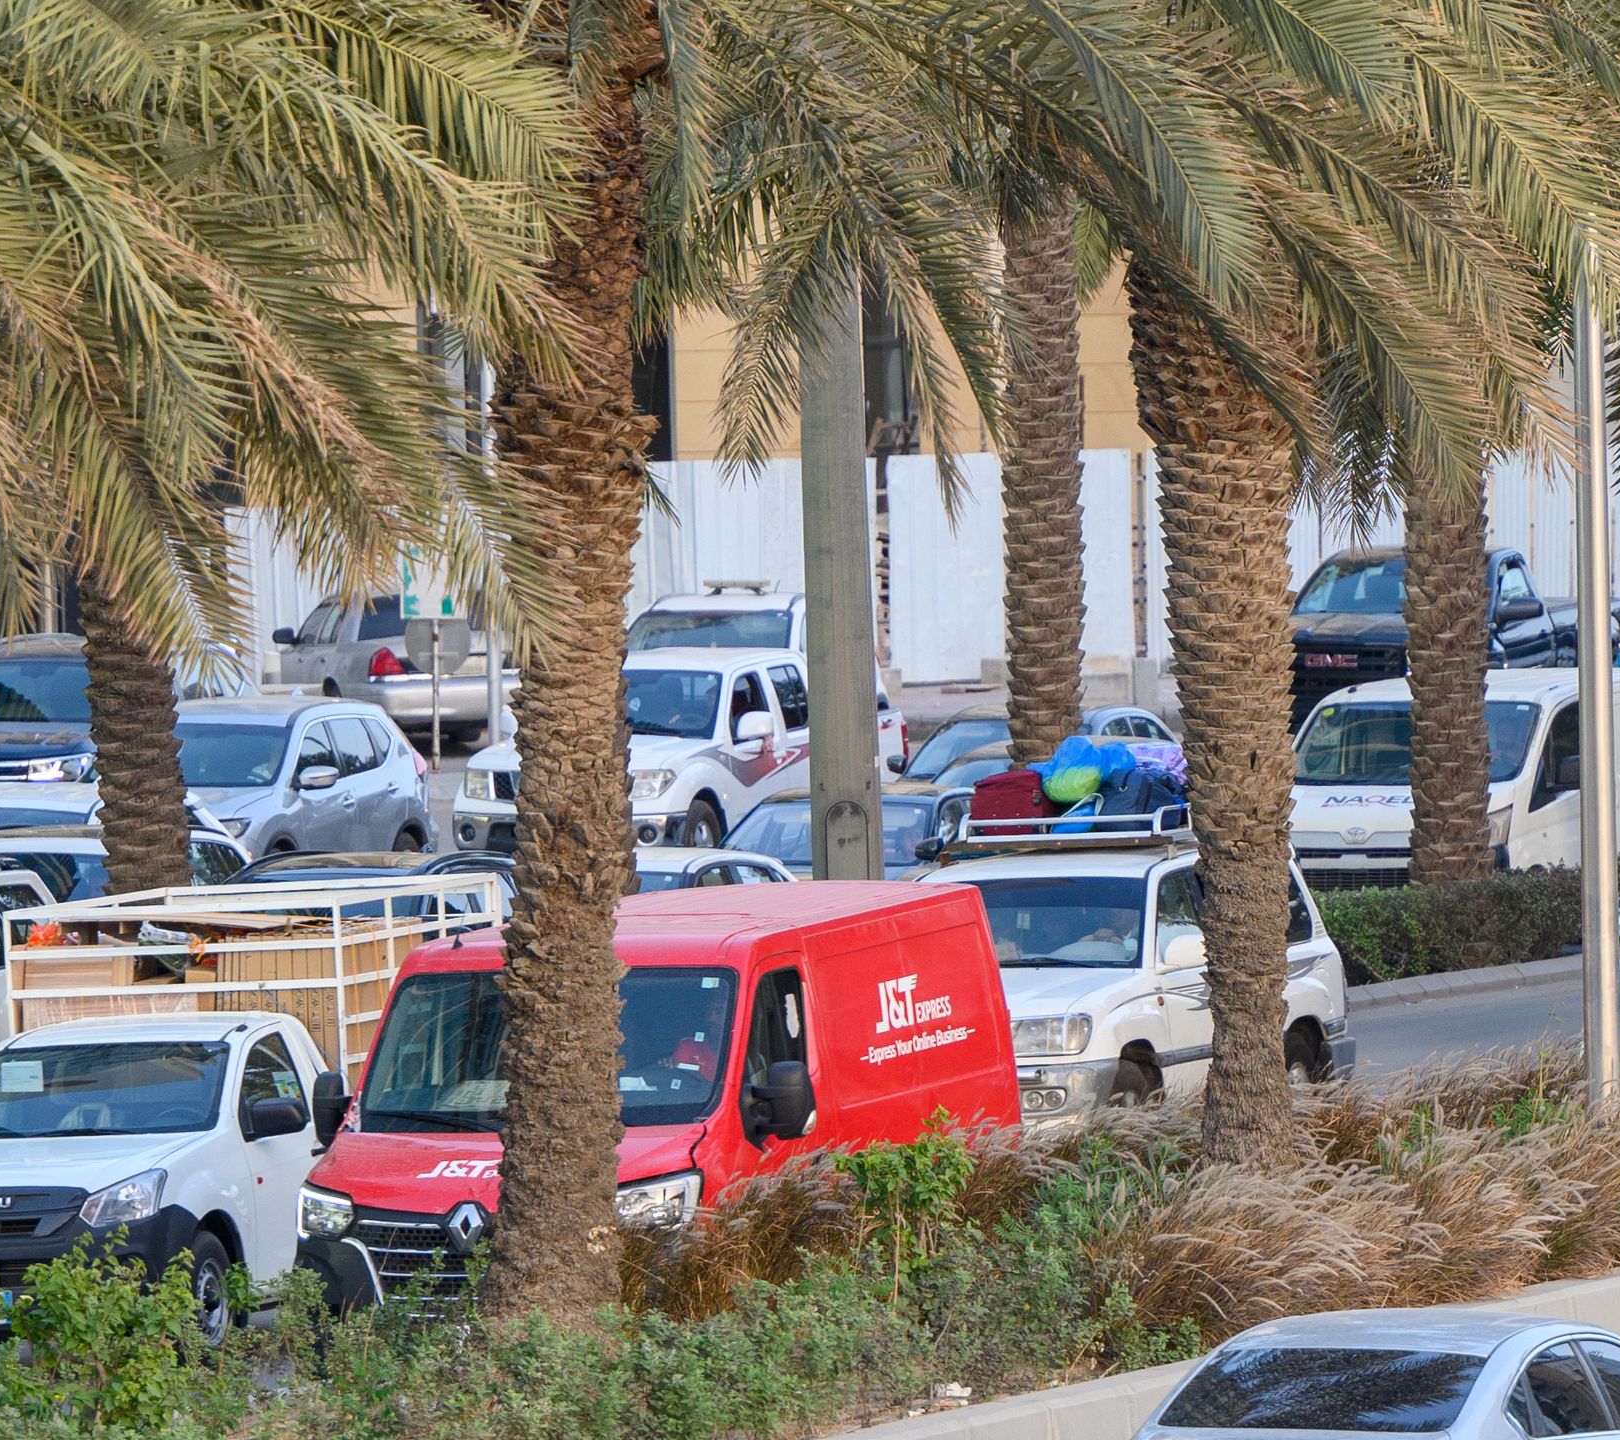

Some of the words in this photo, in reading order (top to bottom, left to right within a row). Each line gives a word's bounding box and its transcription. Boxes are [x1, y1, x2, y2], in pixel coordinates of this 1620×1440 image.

[1305, 654, 1358, 666] GMC
[876, 974, 918, 1034] J&T
[915, 995, 952, 1024] EXPRESS
[868, 1042, 896, 1065] Express
[896, 1039, 913, 1056] Your
[913, 1031, 936, 1053] Online
[936, 1025, 968, 1046] Business
[416, 1159, 502, 1179] J&T
